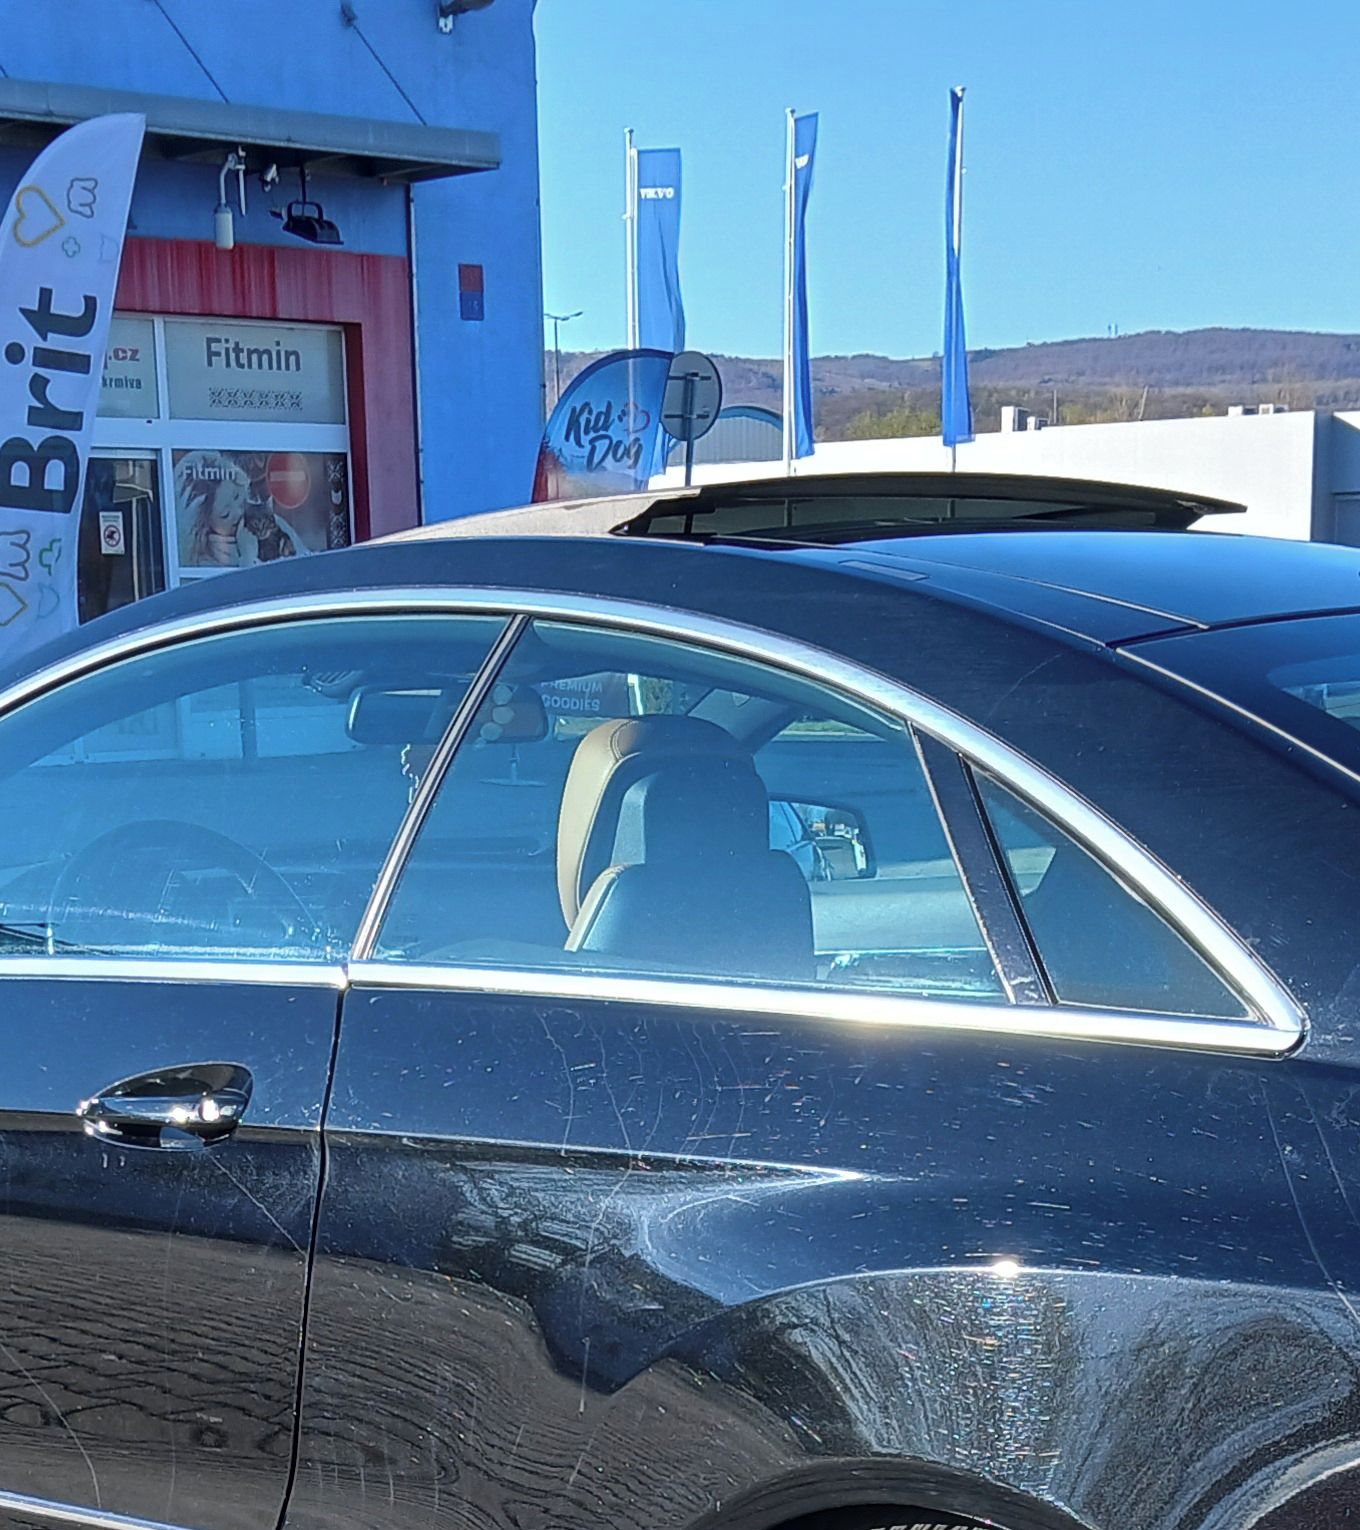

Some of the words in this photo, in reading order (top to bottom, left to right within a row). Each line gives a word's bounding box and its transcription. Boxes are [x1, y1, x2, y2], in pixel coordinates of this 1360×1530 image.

[205, 337, 302, 372] Fitmin
[564, 400, 615, 448] Kid
[586, 433, 644, 472] Dog
[182, 464, 236, 481] Fitmin
[542, 694, 601, 711] GOODIES
